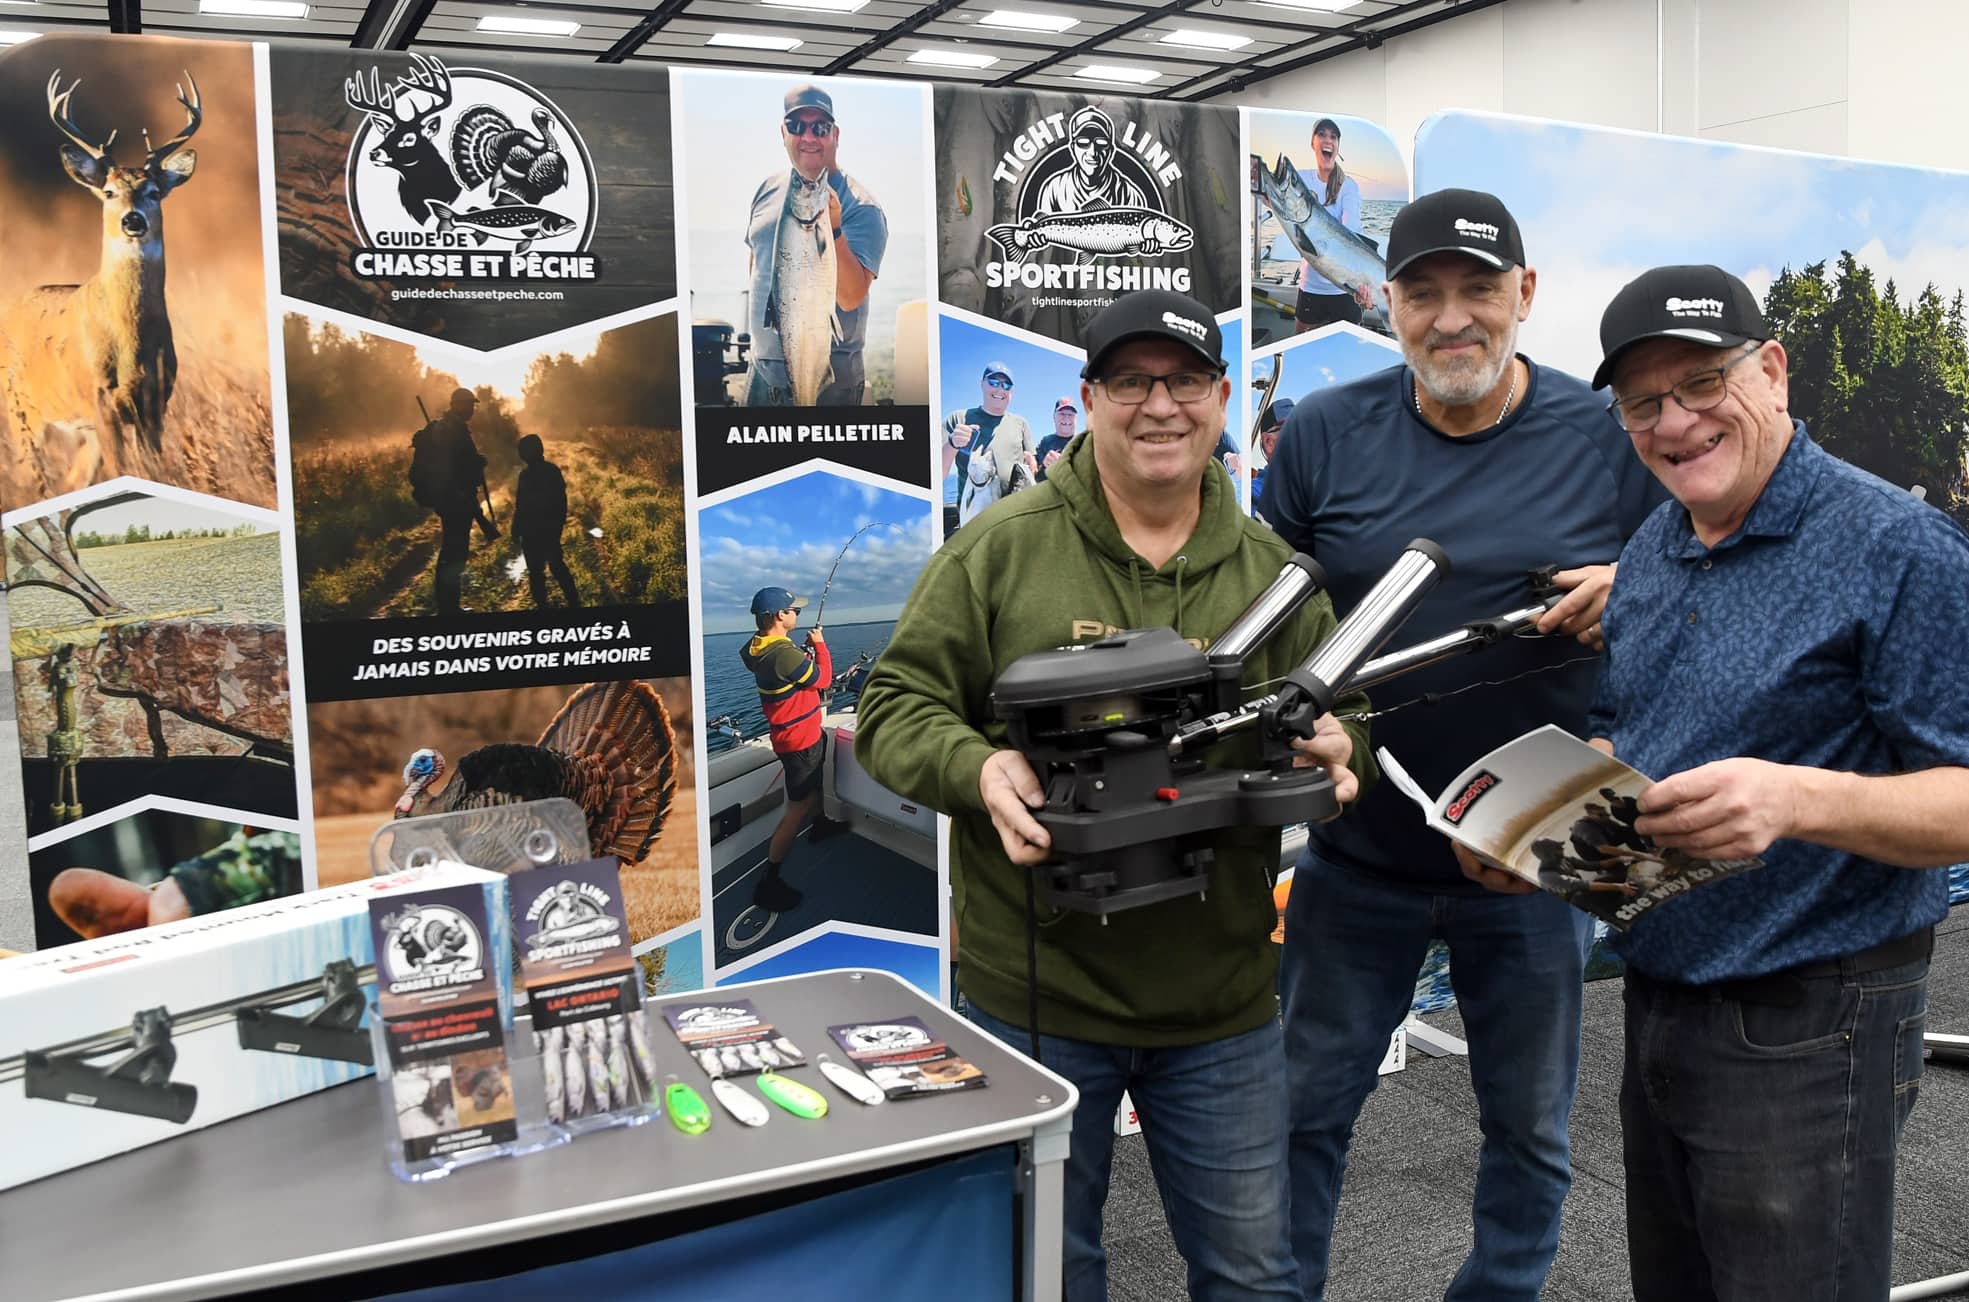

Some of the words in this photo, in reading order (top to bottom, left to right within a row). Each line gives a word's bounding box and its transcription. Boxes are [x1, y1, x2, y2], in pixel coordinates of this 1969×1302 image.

[992, 112, 1067, 186] TIGHT
[1121, 121, 1183, 188] LINE
[376, 230, 438, 247] GUIDE
[442, 232, 469, 248] DE
[354, 253, 464, 278] CHASSE
[470, 255, 503, 278] ET
[509, 252, 596, 280] PÊCHE
[985, 263, 1191, 292] SPORTFISHING
[391, 288, 564, 301] guidedechasseetpeche.com
[726, 425, 792, 444] ALAIN
[797, 424, 905, 442] PELLETIER
[372, 637, 413, 655] DES
[418, 629, 533, 652] SOUVENIRS
[536, 622, 613, 645] GRAVÉS
[616, 620, 631, 640] À
[353, 660, 430, 682] JAMAIS
[435, 658, 491, 676] DANS
[496, 652, 559, 671] VOTRE
[563, 646, 652, 667] MÉMOIRE
[1446, 775, 1494, 821] Scotty
[1615, 896, 1652, 921] the
[1649, 876, 1692, 899] way
[1687, 866, 1714, 881] to
